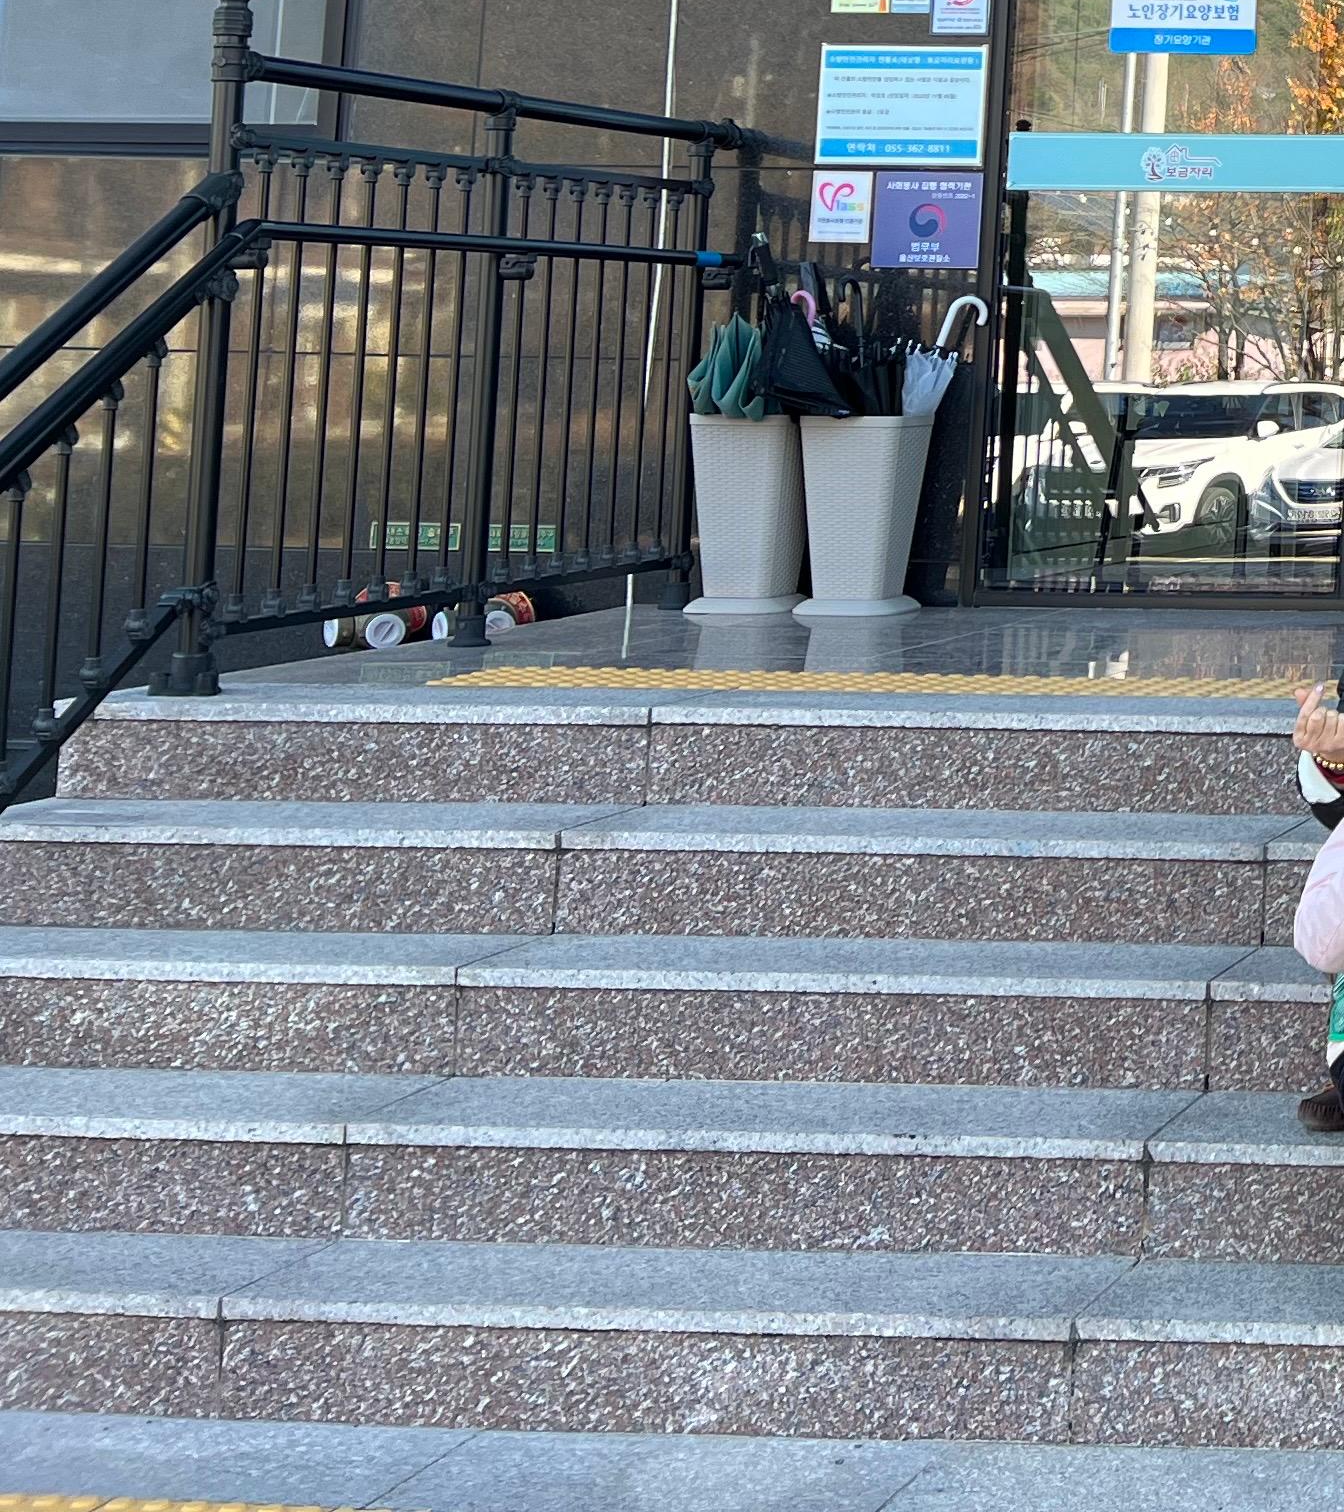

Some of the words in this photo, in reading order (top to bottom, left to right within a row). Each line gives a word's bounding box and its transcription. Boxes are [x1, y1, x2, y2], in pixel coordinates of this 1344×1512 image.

[1127, 3, 1240, 21] 노인장기요양보험
[1153, 33, 1211, 46] 장기요양기관
[1165, 165, 1213, 178] 보금자리
[910, 242, 940, 252] 법무부
